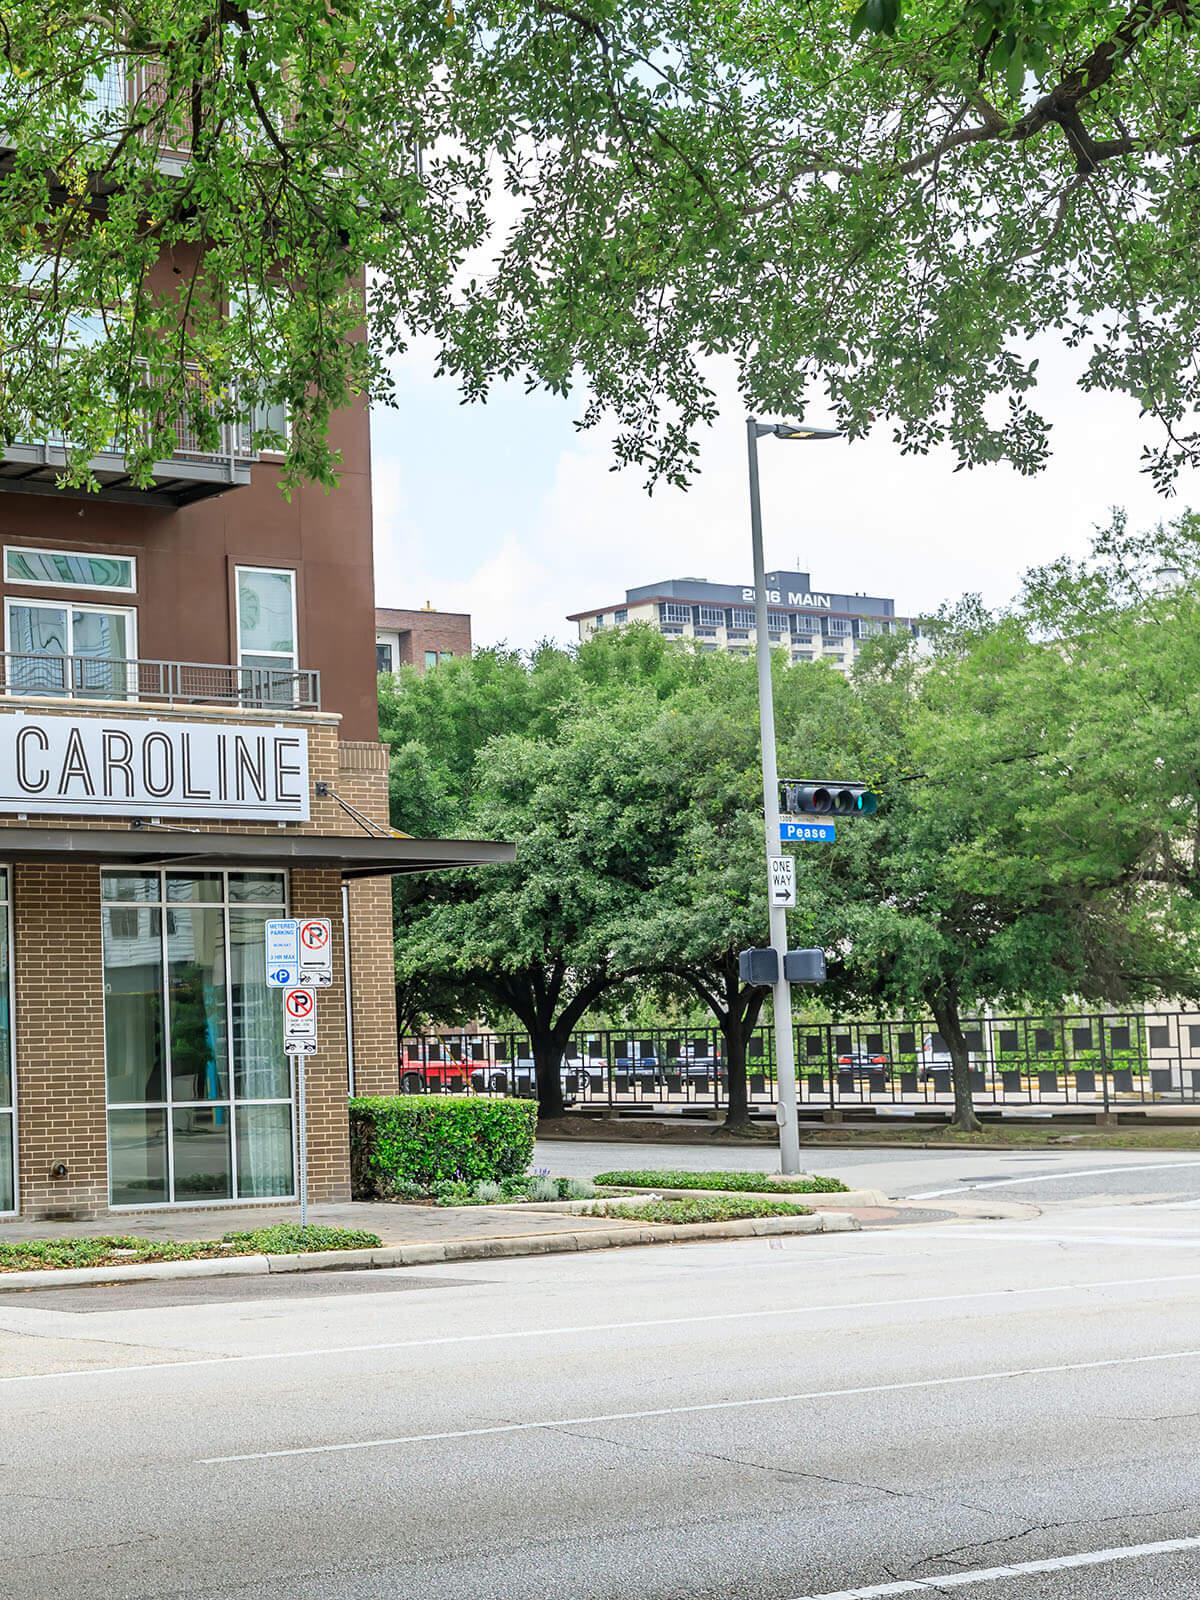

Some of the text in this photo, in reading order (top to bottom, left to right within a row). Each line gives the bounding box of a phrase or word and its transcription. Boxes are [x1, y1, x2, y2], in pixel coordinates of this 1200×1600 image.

[742, 588, 831, 608] 216 MAIN
[16, 726, 302, 803] CAROLINE
[787, 825, 826, 838] Pease
[772, 860, 791, 872] ONE
[773, 875, 792, 886] WAY
